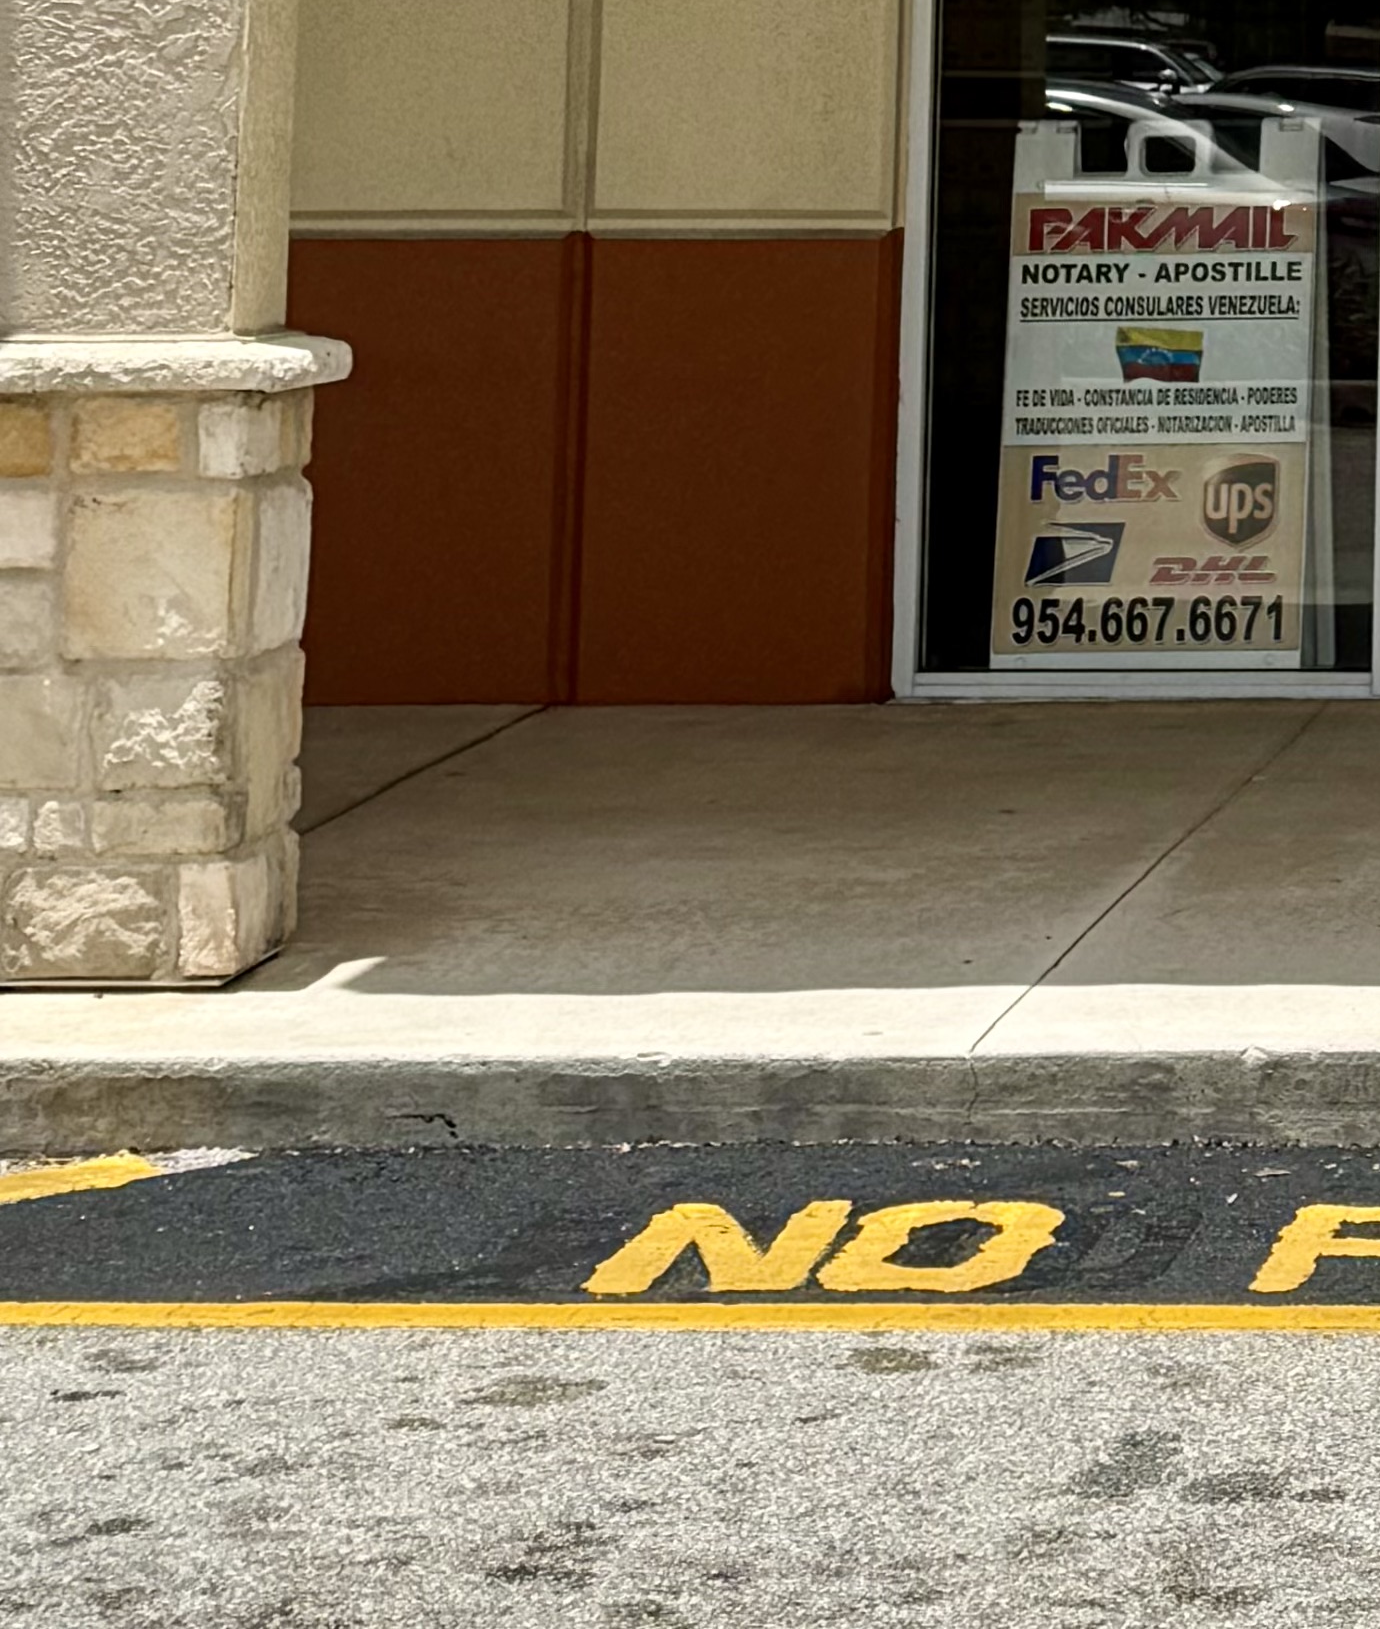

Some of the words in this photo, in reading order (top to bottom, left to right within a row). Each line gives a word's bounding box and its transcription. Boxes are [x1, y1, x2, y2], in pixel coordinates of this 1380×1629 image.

[1021, 264, 1129, 285] NOTARY
[1154, 262, 1302, 284] APOSTILLE
[1020, 297, 1100, 318] SERVICIOS
[1103, 296, 1203, 317] CONSULARES
[1208, 295, 1301, 317] VENEZUELA:
[1016, 390, 1030, 407] FE
[1032, 389, 1046, 407] DE
[1049, 389, 1075, 406] VIDA
[1084, 388, 1154, 406] CONSTANCIA
[1156, 388, 1171, 405] DE
[1173, 387, 1239, 405] RESIDENCIA
[1247, 387, 1298, 405] PODERES
[1015, 417, 1093, 435] TRADUCCIONES
[1096, 416, 1149, 434] OFICIALES
[1239, 415, 1296, 433] APOSTILLA
[1030, 454, 1182, 503] FedEx
[1204, 483, 1272, 533] ups
[1148, 555, 1278, 585] DHL
[1011, 594, 1284, 646] 954.667.6671
[581, 1197, 1066, 1294] NO
